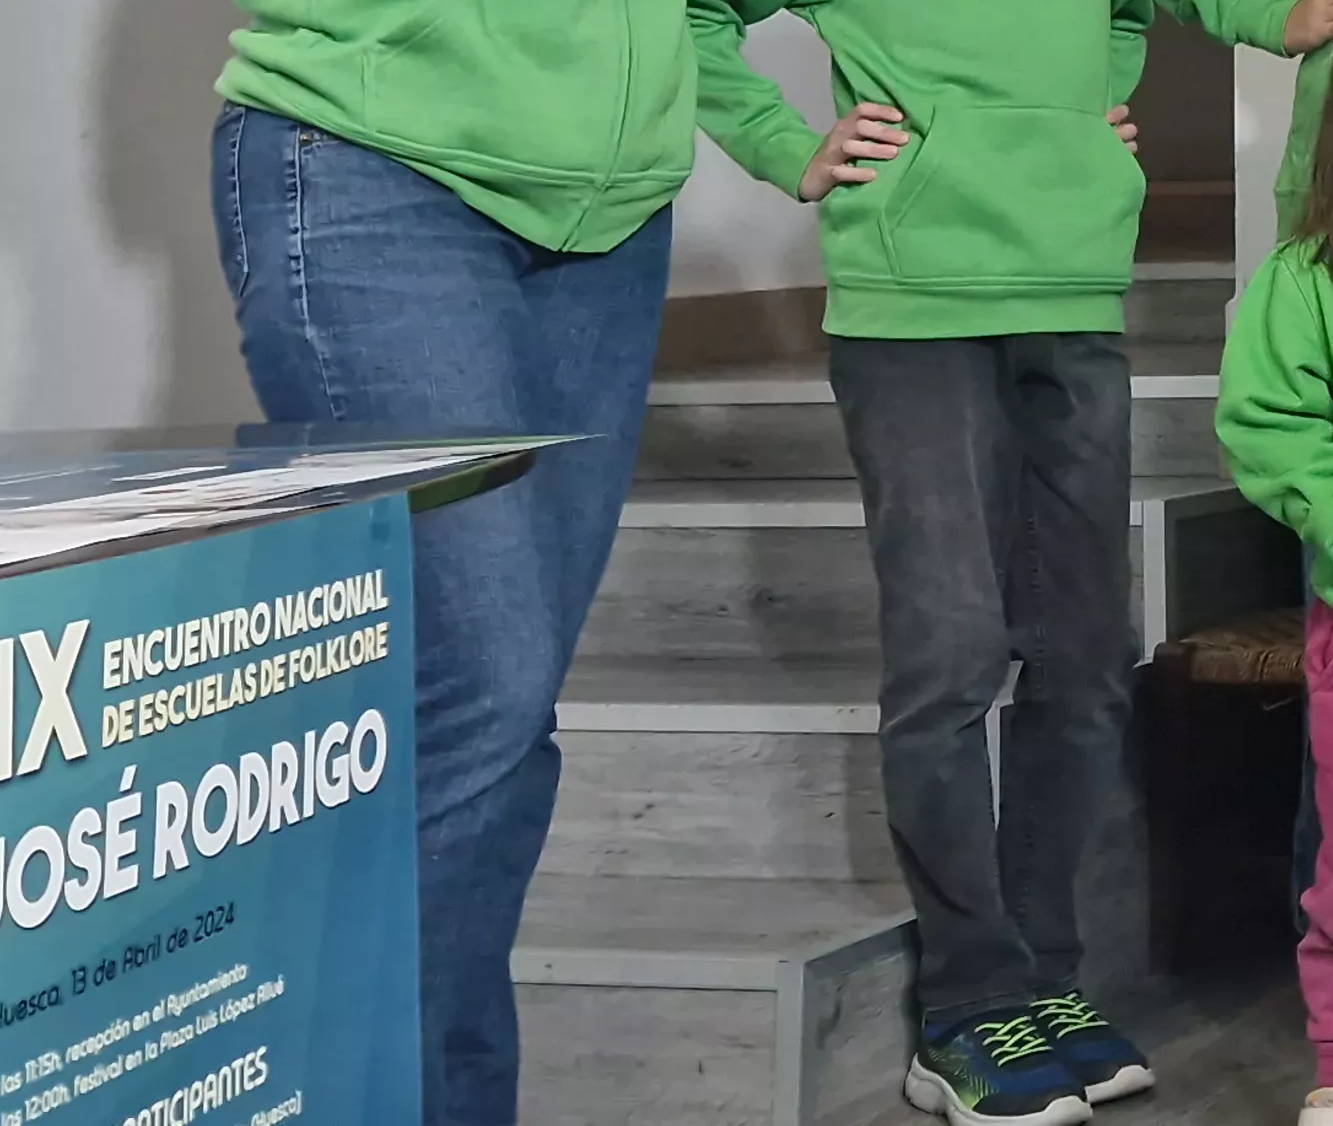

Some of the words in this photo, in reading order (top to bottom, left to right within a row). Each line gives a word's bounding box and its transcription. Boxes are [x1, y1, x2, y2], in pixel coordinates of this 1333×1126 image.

[103, 602, 271, 690] ENCUENTRO
[274, 568, 389, 640] NACIONAL
[102, 699, 134, 748] DE
[138, 662, 257, 736] ESCUELAS
[259, 654, 287, 698] DE
[288, 622, 389, 688] FOLKLORE
[0, 765, 142, 930] OSÉ
[153, 708, 388, 879] RODRIGO
[72, 966, 87, 996] 13
[93, 957, 116, 987] de
[122, 934, 161, 972] Abril
[166, 927, 188, 954] de
[193, 901, 235, 943] 2024
[65, 1018, 131, 1064] recepción
[132, 1010, 151, 1032] en
[152, 999, 165, 1023] el
[167, 963, 248, 1017] Ayuntamiento
[74, 1054, 124, 1097] festival
[125, 1049, 143, 1071] en
[145, 1039, 158, 1061] la
[160, 1024, 194, 1054] Plaza
